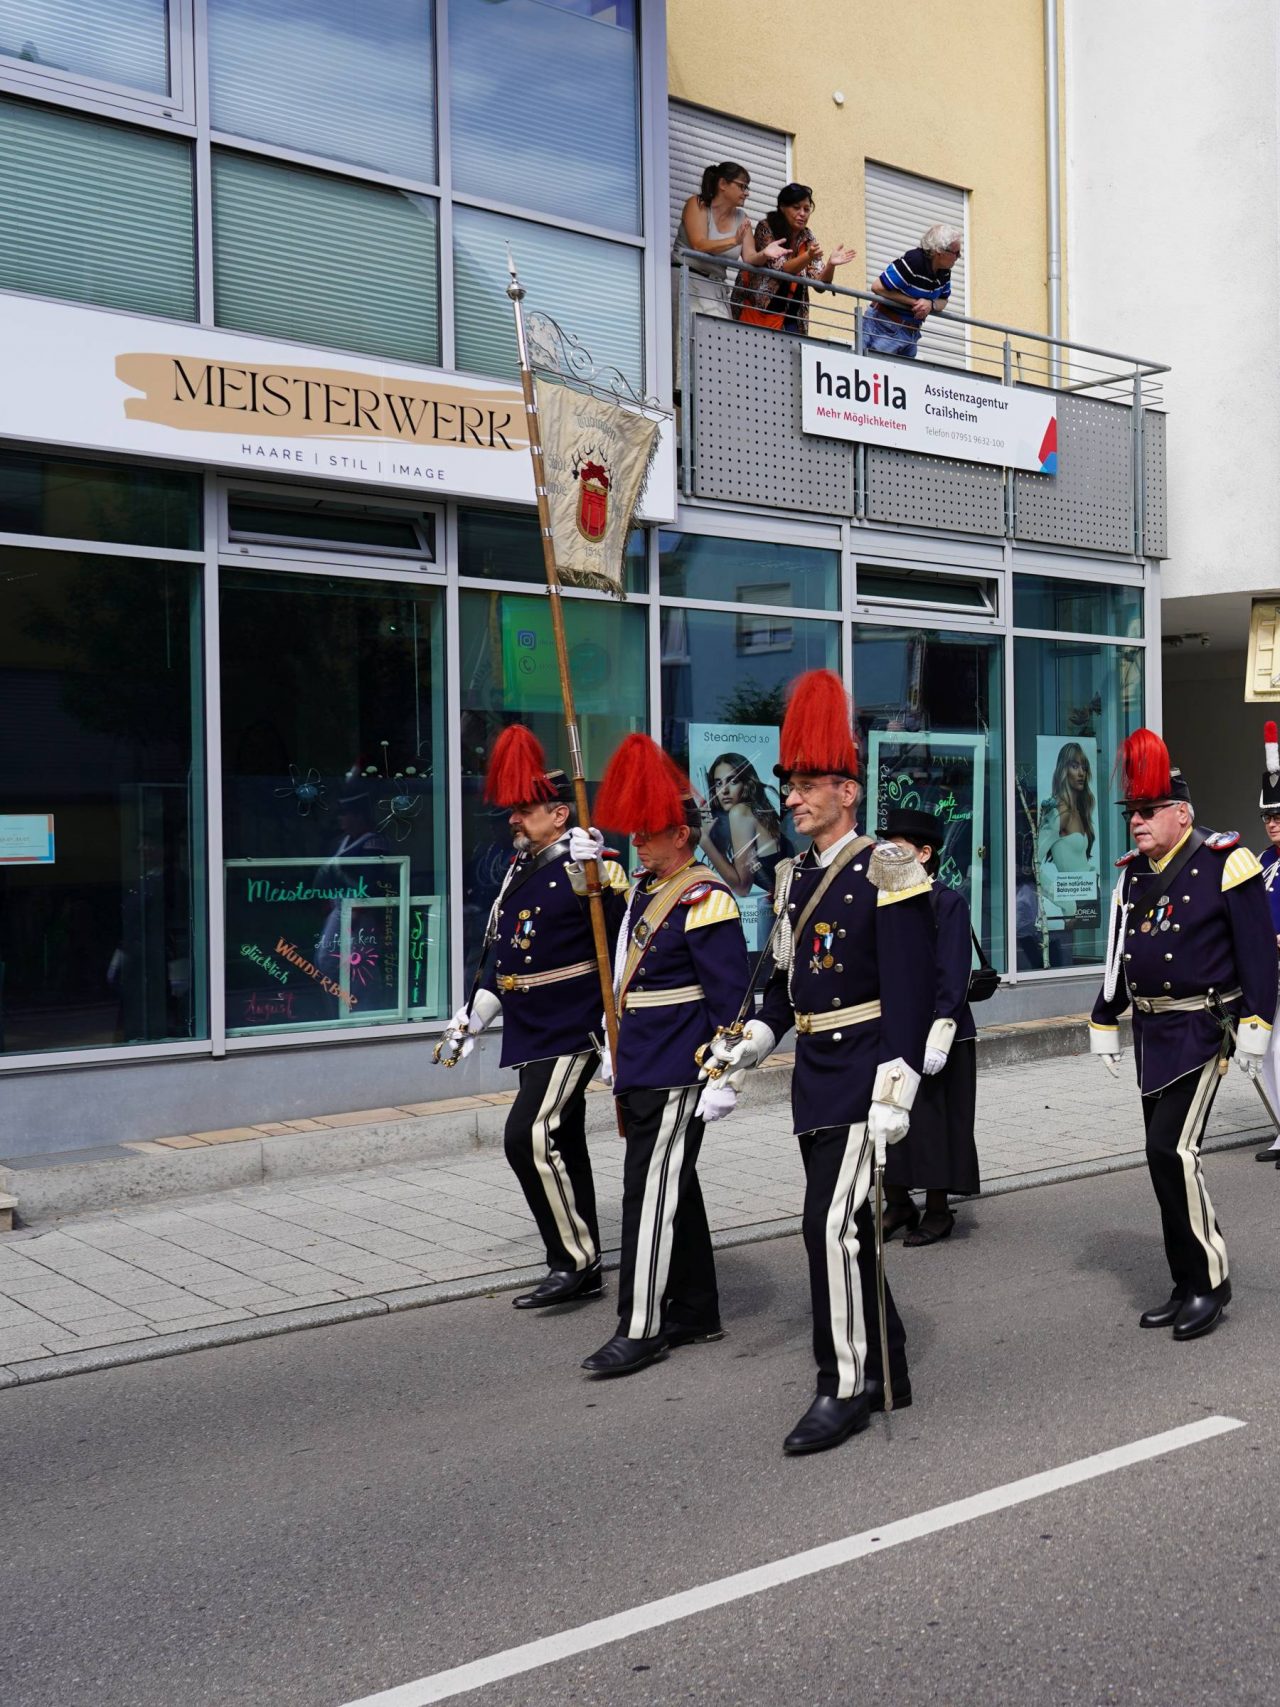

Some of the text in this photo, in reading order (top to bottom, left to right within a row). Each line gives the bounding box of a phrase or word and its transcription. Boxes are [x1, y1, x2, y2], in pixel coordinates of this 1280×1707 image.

[815, 360, 908, 410] habila
[924, 384, 1009, 411] Assistenzagentur
[172, 359, 514, 451] MEISTERWERK
[816, 405, 907, 432] Mehr Möglichkeiten
[924, 403, 978, 424] Crailsheim
[925, 426, 950, 439] Telefon
[951, 431, 973, 443] 07951
[241, 443, 446, 480] HAARE STIL IMAGE
[703, 731, 770, 744] SteamPod 3.0
[247, 876, 370, 903] Meisterwerk
[239, 943, 290, 985] glücklich
